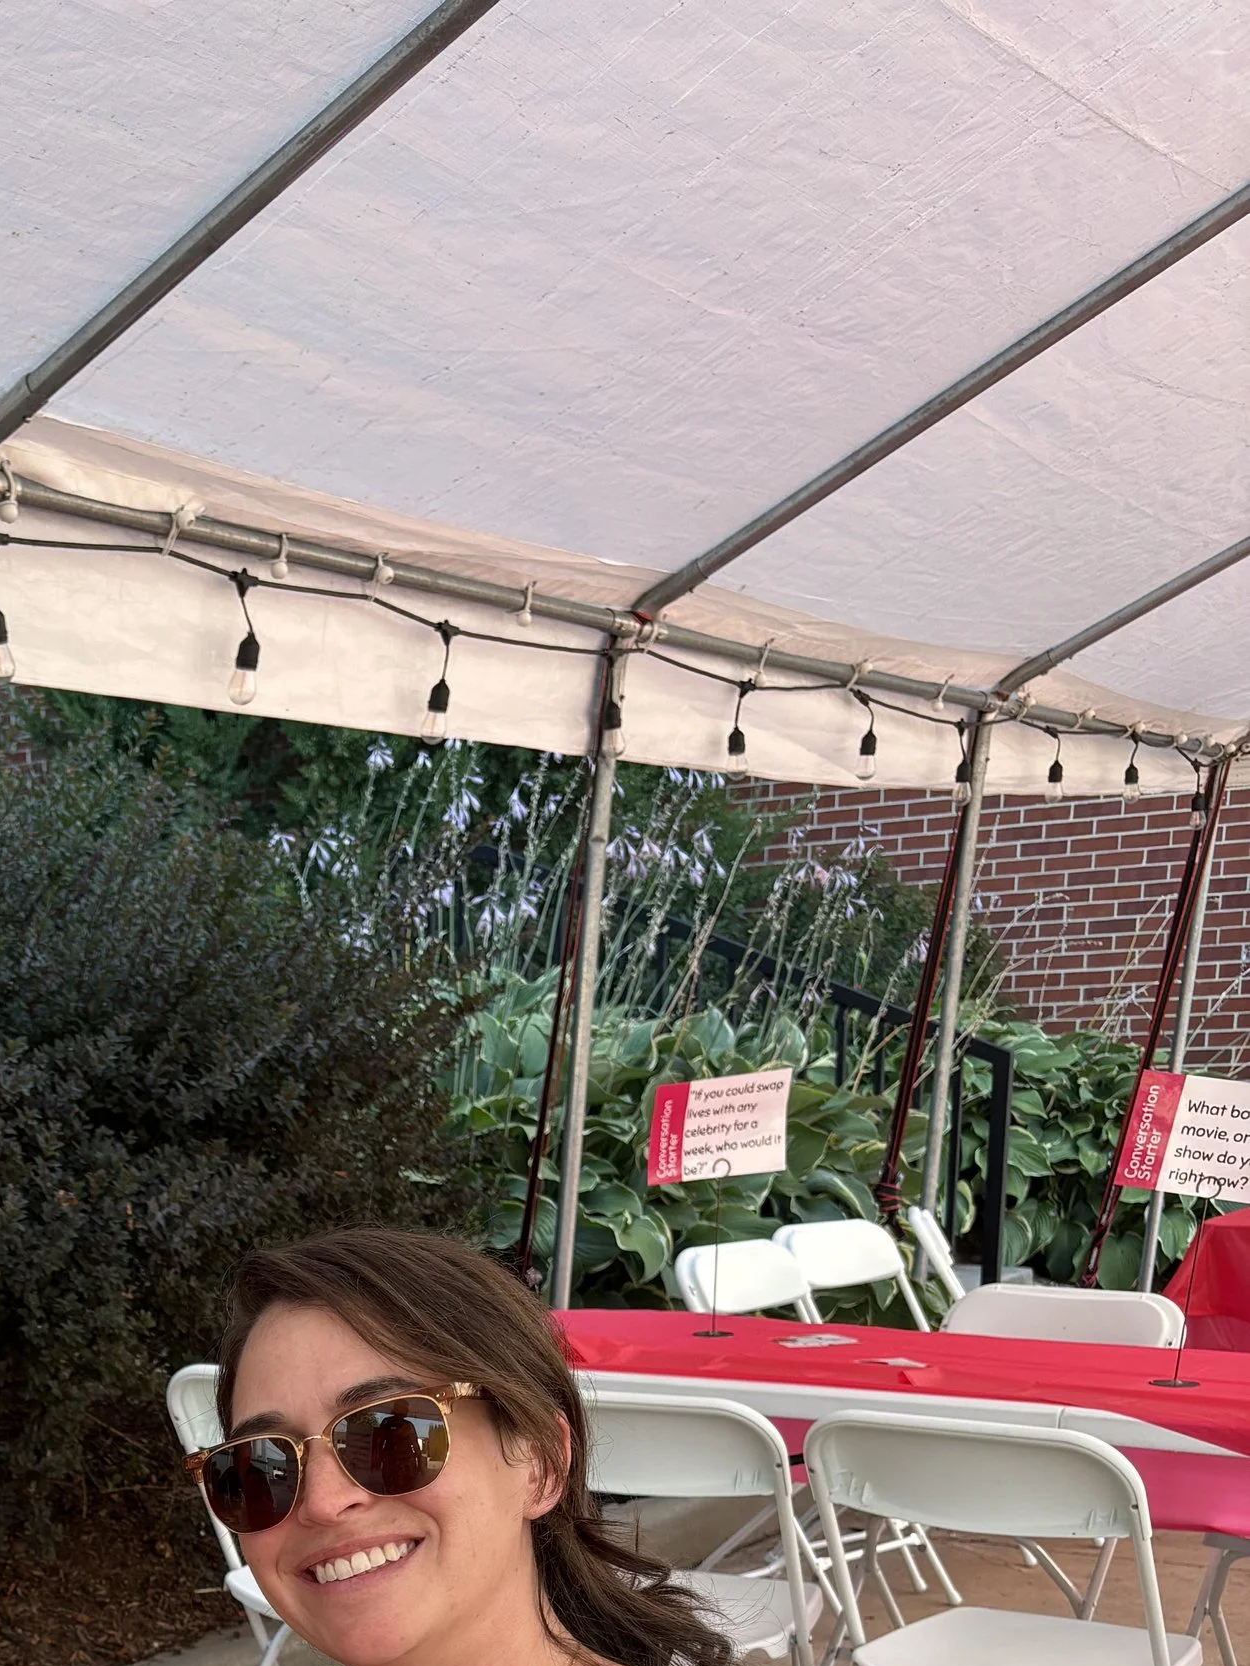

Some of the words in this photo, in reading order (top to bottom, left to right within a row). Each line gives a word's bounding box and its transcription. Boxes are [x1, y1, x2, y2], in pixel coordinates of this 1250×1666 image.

[704, 1090, 724, 1103] you
[725, 1083, 755, 1097] could
[756, 1081, 784, 1093] swap
[686, 1107, 711, 1119] lives
[713, 1103, 735, 1115] with
[737, 1102, 758, 1113] any
[1187, 1099, 1227, 1117] What
[656, 1099, 673, 1179] Conversation
[684, 1123, 732, 1138] celebrity
[734, 1119, 749, 1131] for
[750, 1120, 758, 1129] a
[1124, 1085, 1160, 1180] Conversation
[1181, 1124, 1229, 1143] movie,
[666, 1133, 678, 1178] Starter
[683, 1142, 714, 1157] week,
[715, 1141, 738, 1153] who
[740, 1135, 772, 1149] would
[774, 1134, 782, 1144] it
[1137, 1128, 1163, 1181] Starter
[1174, 1145, 1214, 1162] show
[1216, 1150, 1237, 1165] do
[1239, 1156, 1250, 1170] y
[1168, 1168, 1205, 1185] right
[1206, 1175, 1249, 1190] now?
